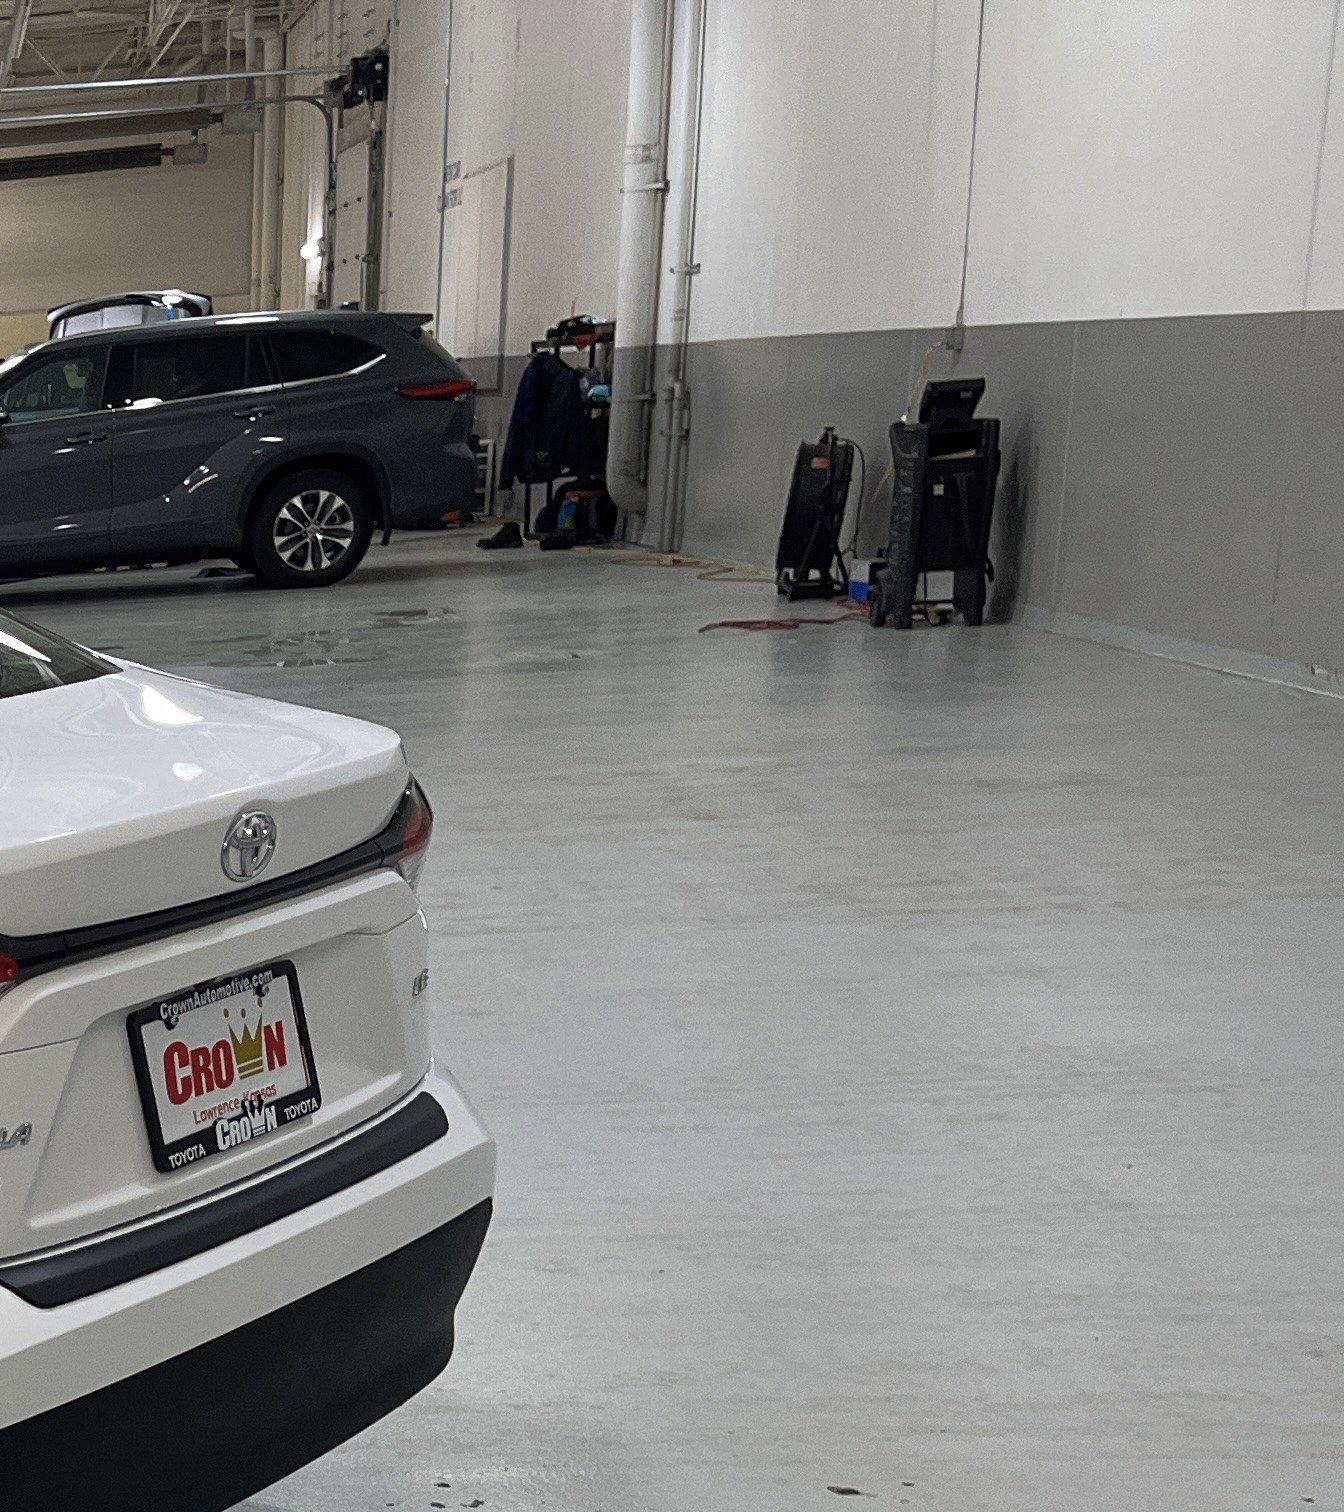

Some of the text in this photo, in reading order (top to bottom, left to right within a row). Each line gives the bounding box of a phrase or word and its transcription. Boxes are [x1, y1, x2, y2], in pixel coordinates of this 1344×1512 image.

[159, 970, 273, 1020] CrownAutomotive.com
[168, 1143, 207, 1169] TOYOTA
[283, 1097, 318, 1121] TOYOTA
[192, 1098, 241, 1125] Lawrence
